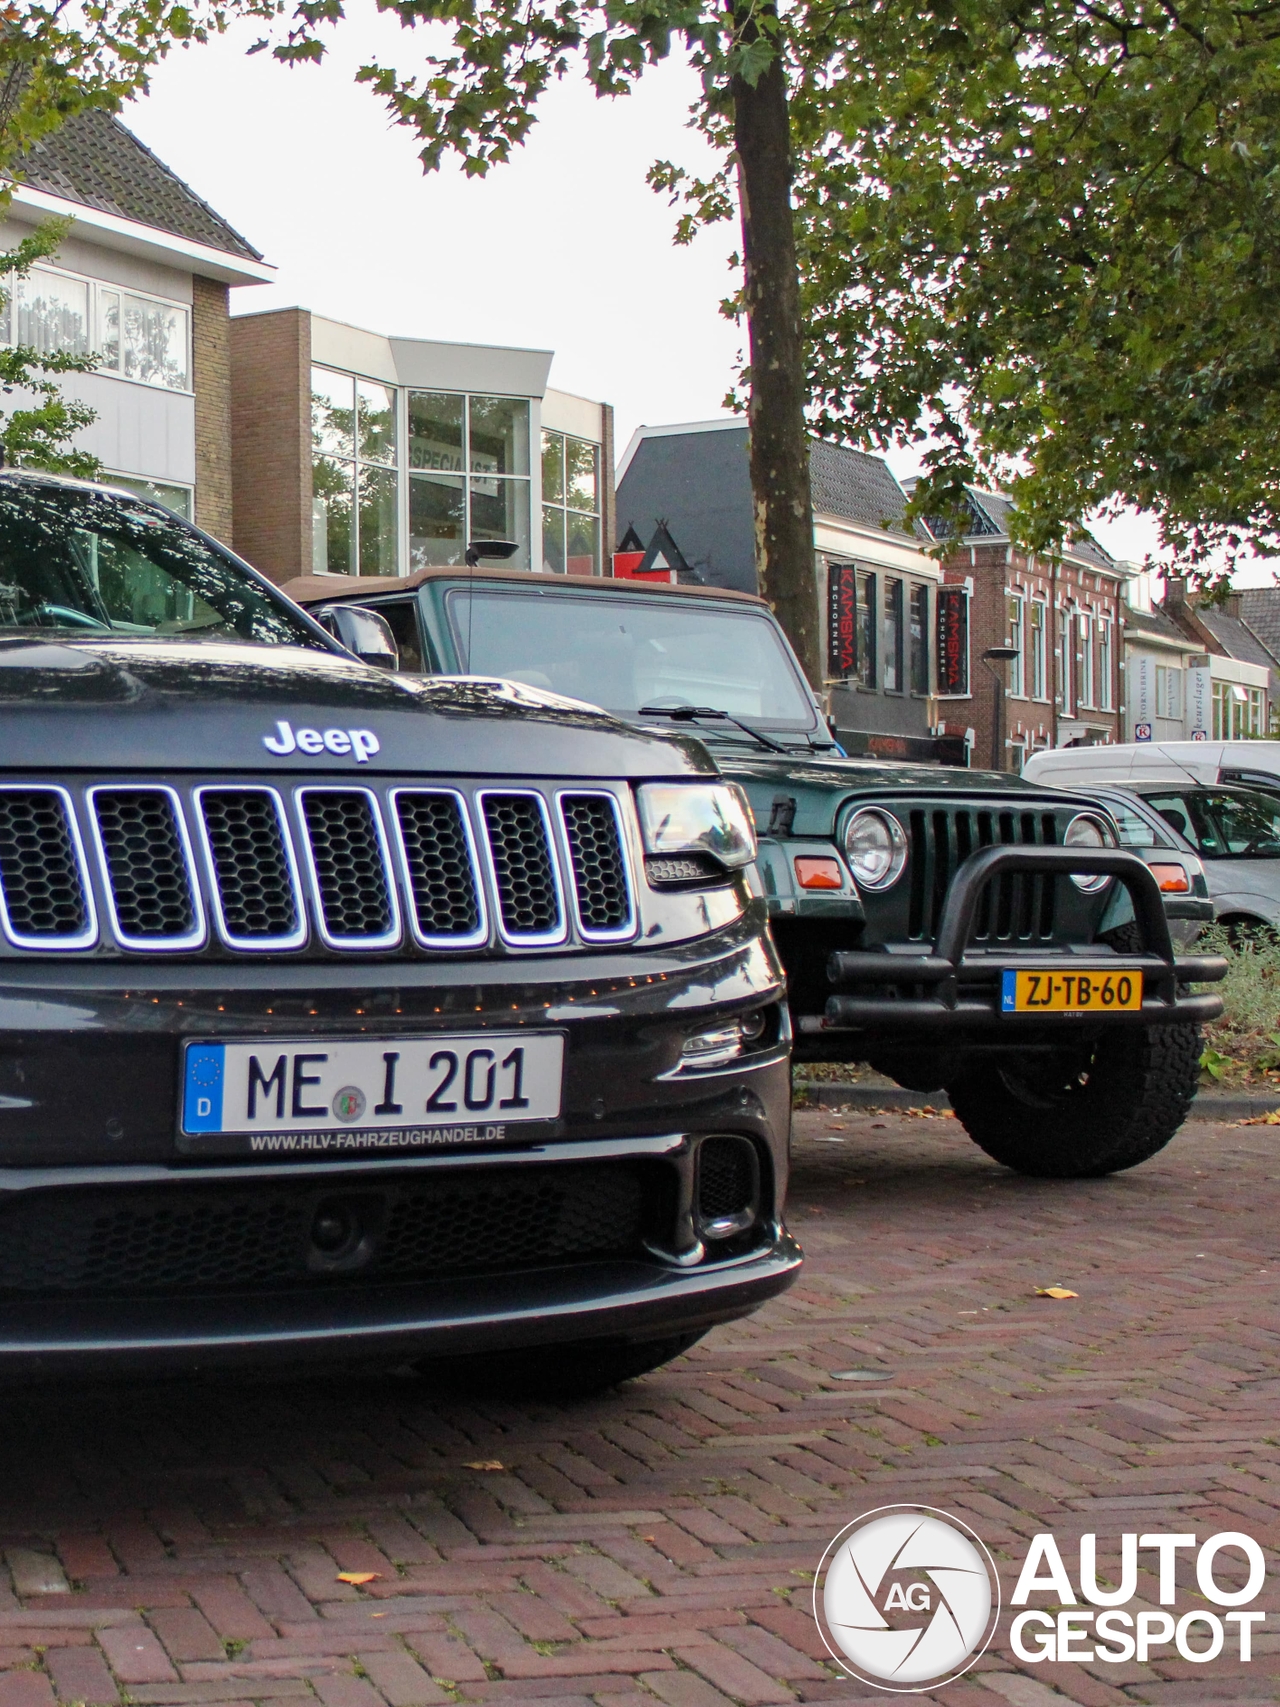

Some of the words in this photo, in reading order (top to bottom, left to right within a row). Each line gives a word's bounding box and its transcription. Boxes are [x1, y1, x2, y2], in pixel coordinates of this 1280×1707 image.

[840, 569, 854, 669] KAMSMA
[948, 595, 960, 685] KAMSMA
[1194, 672, 1205, 728] keurslager
[263, 720, 380, 764] Jeep
[1003, 995, 1014, 1005] NL
[1026, 976, 1132, 1006] ZJ-TB-60
[246, 1053, 329, 1119] ME
[373, 1051, 404, 1115] I
[425, 1046, 530, 1113] 201
[197, 1097, 212, 1117] D
[250, 1126, 506, 1151] WWW.HLV-FAHRZEUGHANDEL.DE
